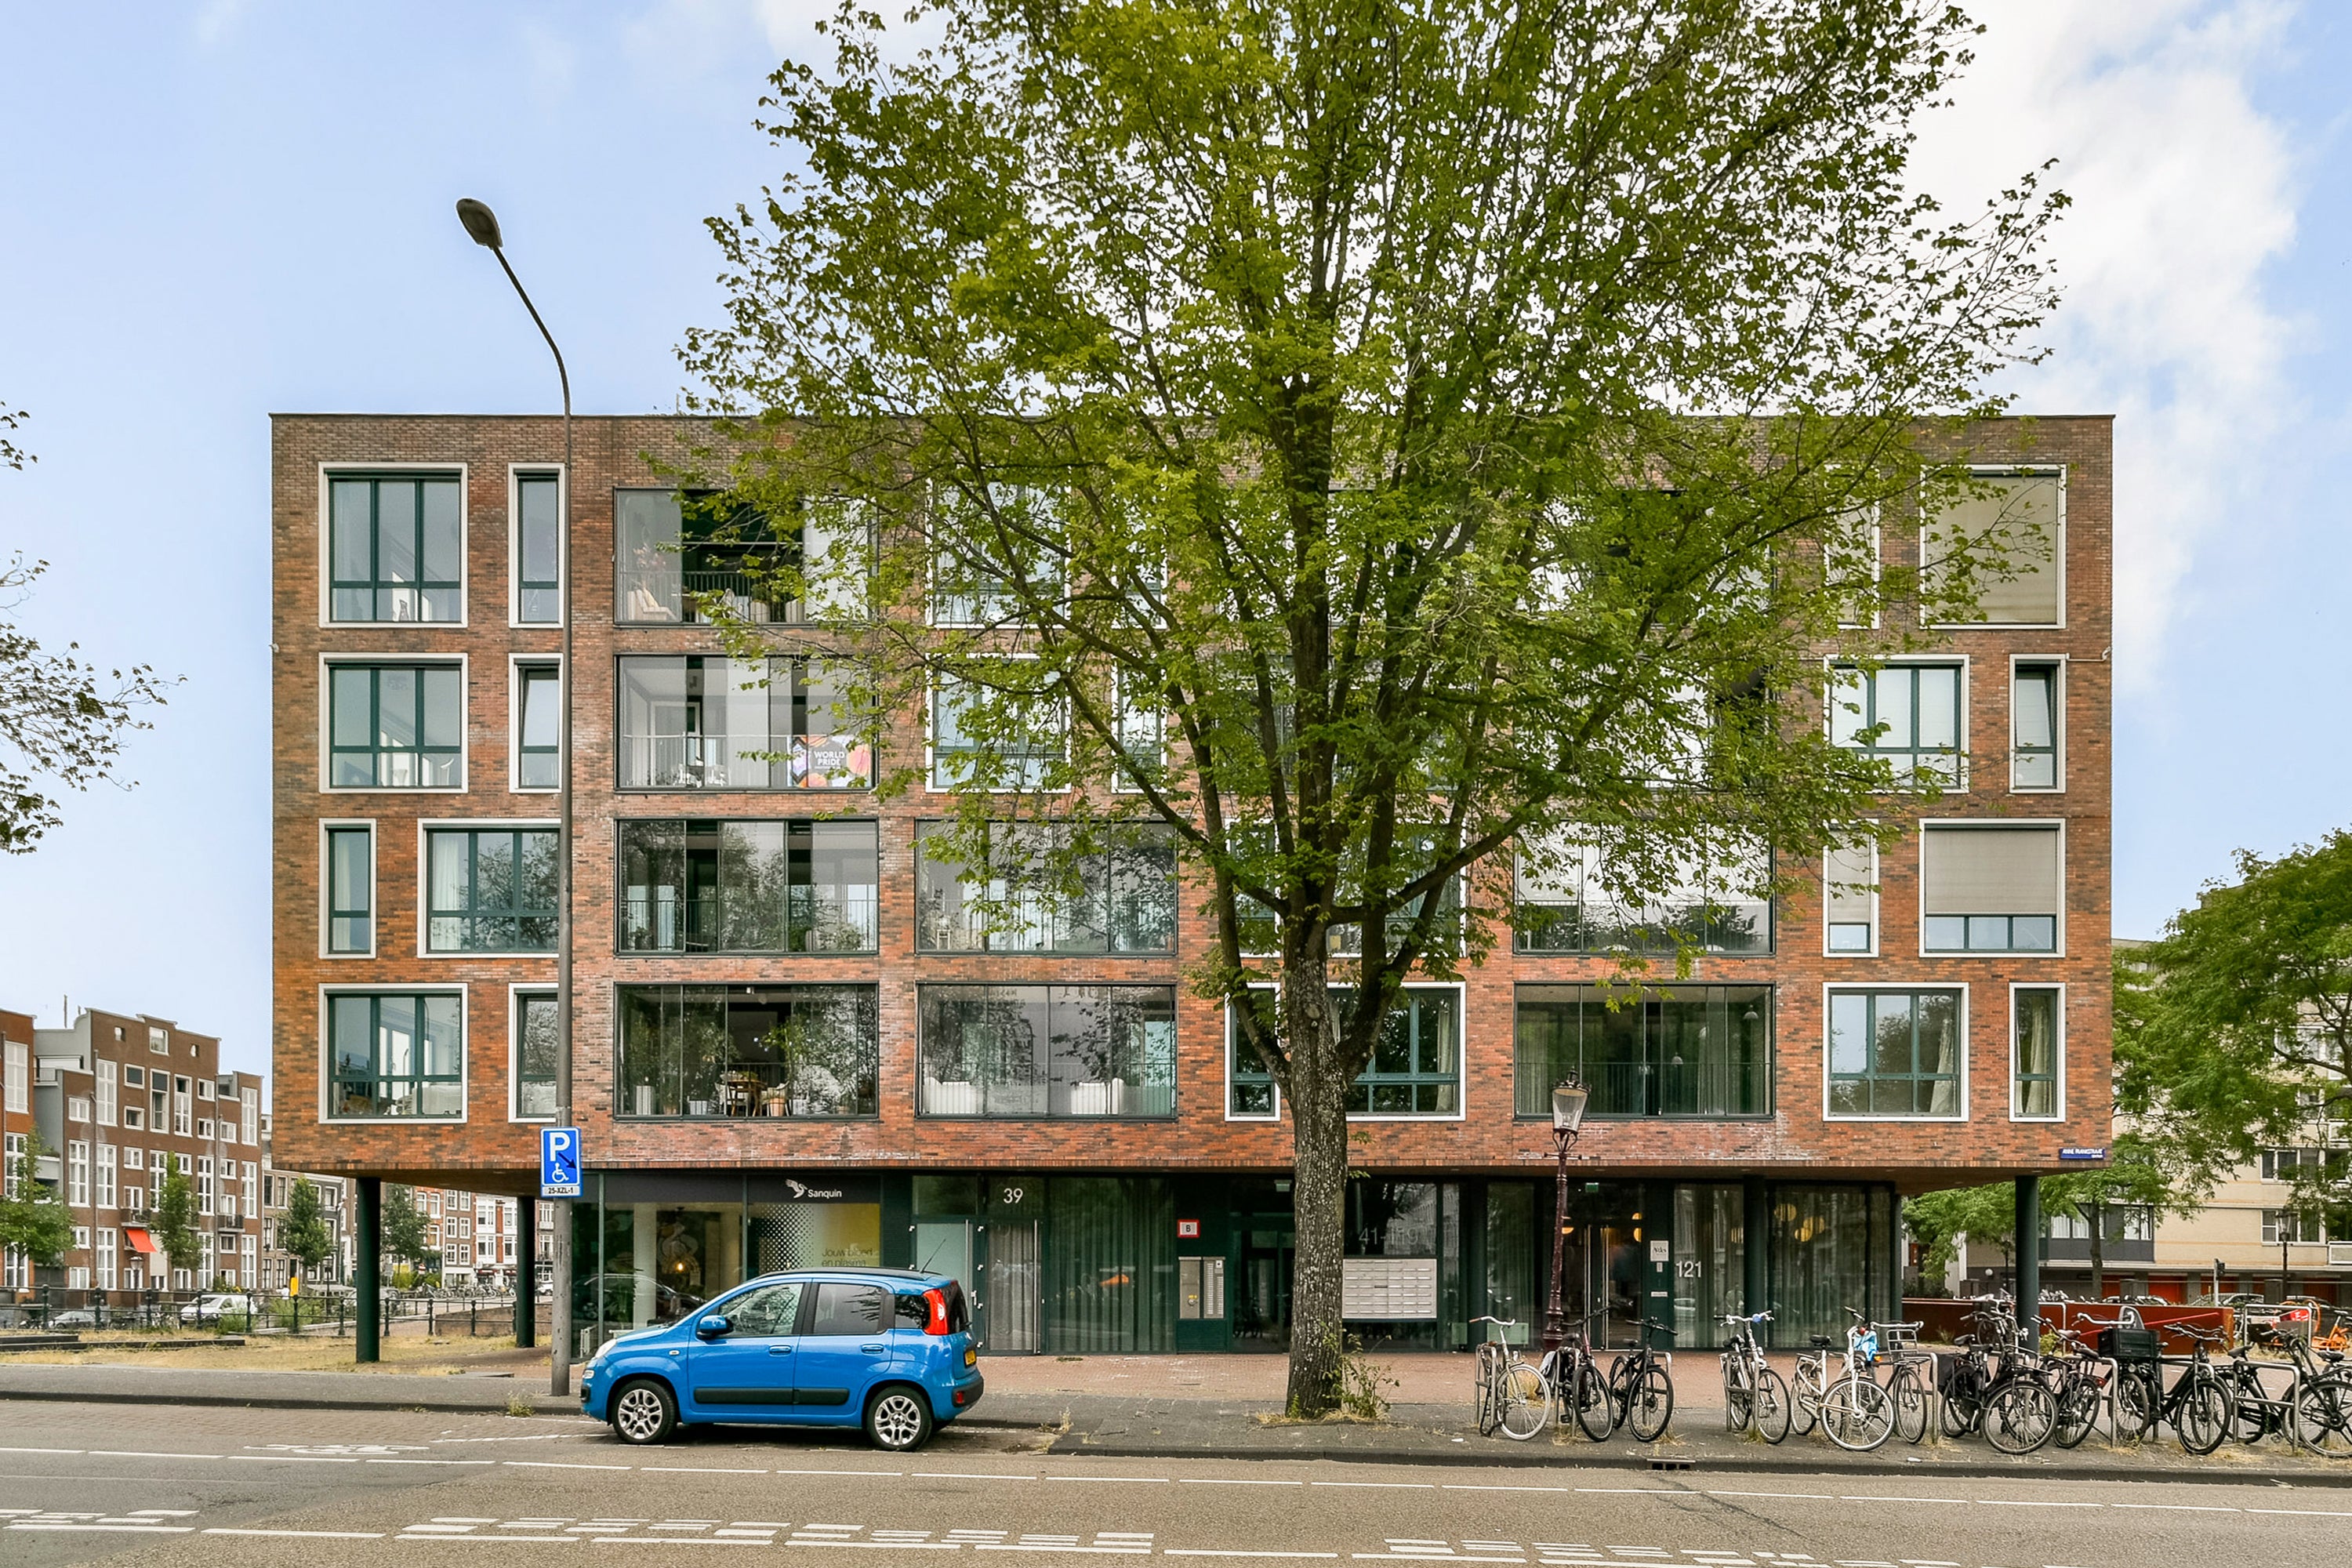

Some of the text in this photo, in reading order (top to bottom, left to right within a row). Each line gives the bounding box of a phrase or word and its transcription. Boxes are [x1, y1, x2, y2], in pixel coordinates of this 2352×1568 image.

[815, 750, 845, 759] WORLD
[550, 1132, 571, 1162] P
[808, 1189, 842, 1199] Sanquin
[1004, 1188, 1023, 1203] 39
[1675, 1261, 1702, 1278] 121
